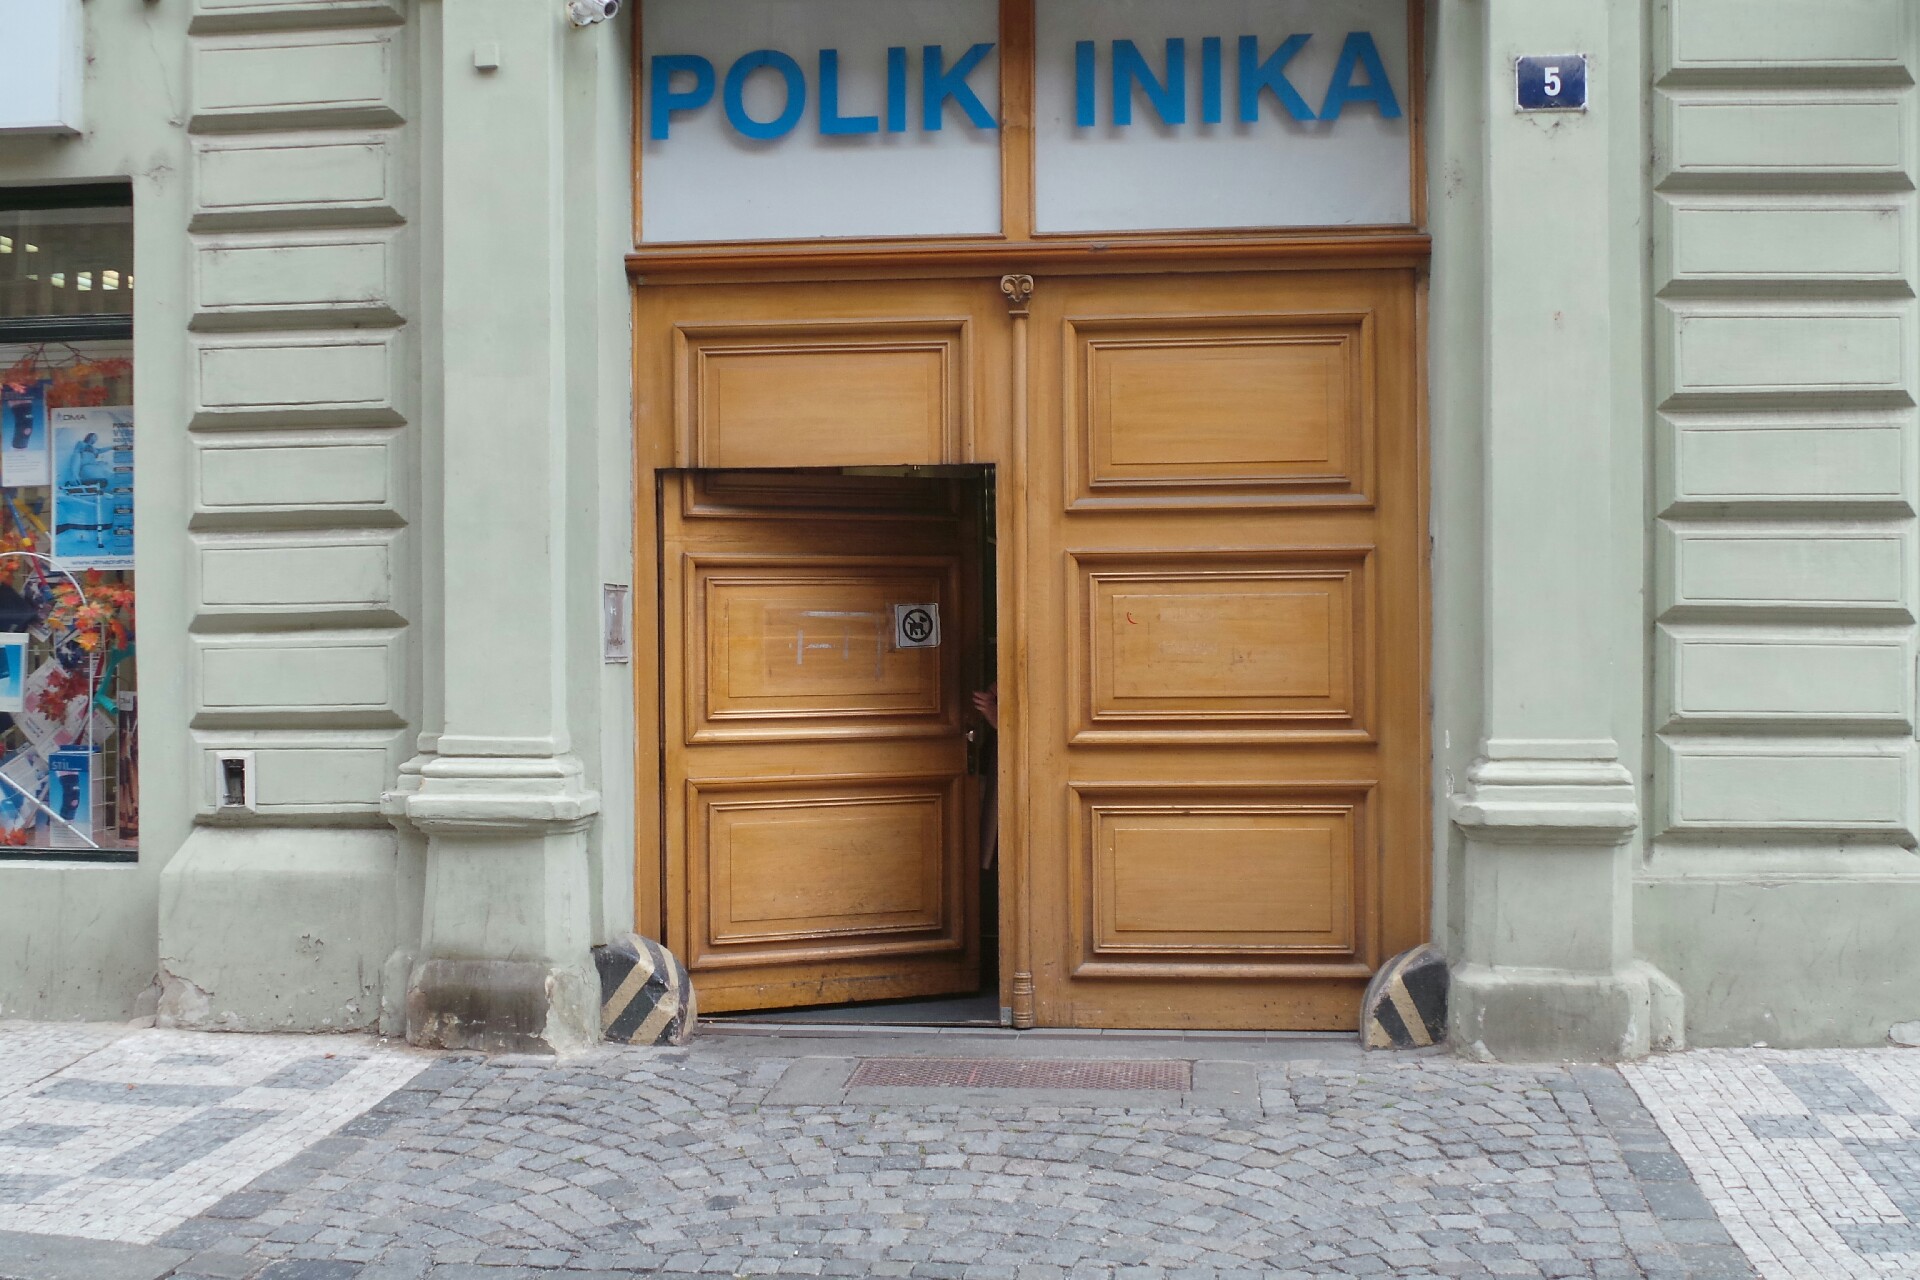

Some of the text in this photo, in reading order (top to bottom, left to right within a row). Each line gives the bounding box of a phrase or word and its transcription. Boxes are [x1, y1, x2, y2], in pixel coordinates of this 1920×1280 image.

[651, 31, 1402, 139] POLIK INIKA
[1544, 66, 1561, 96] 5
